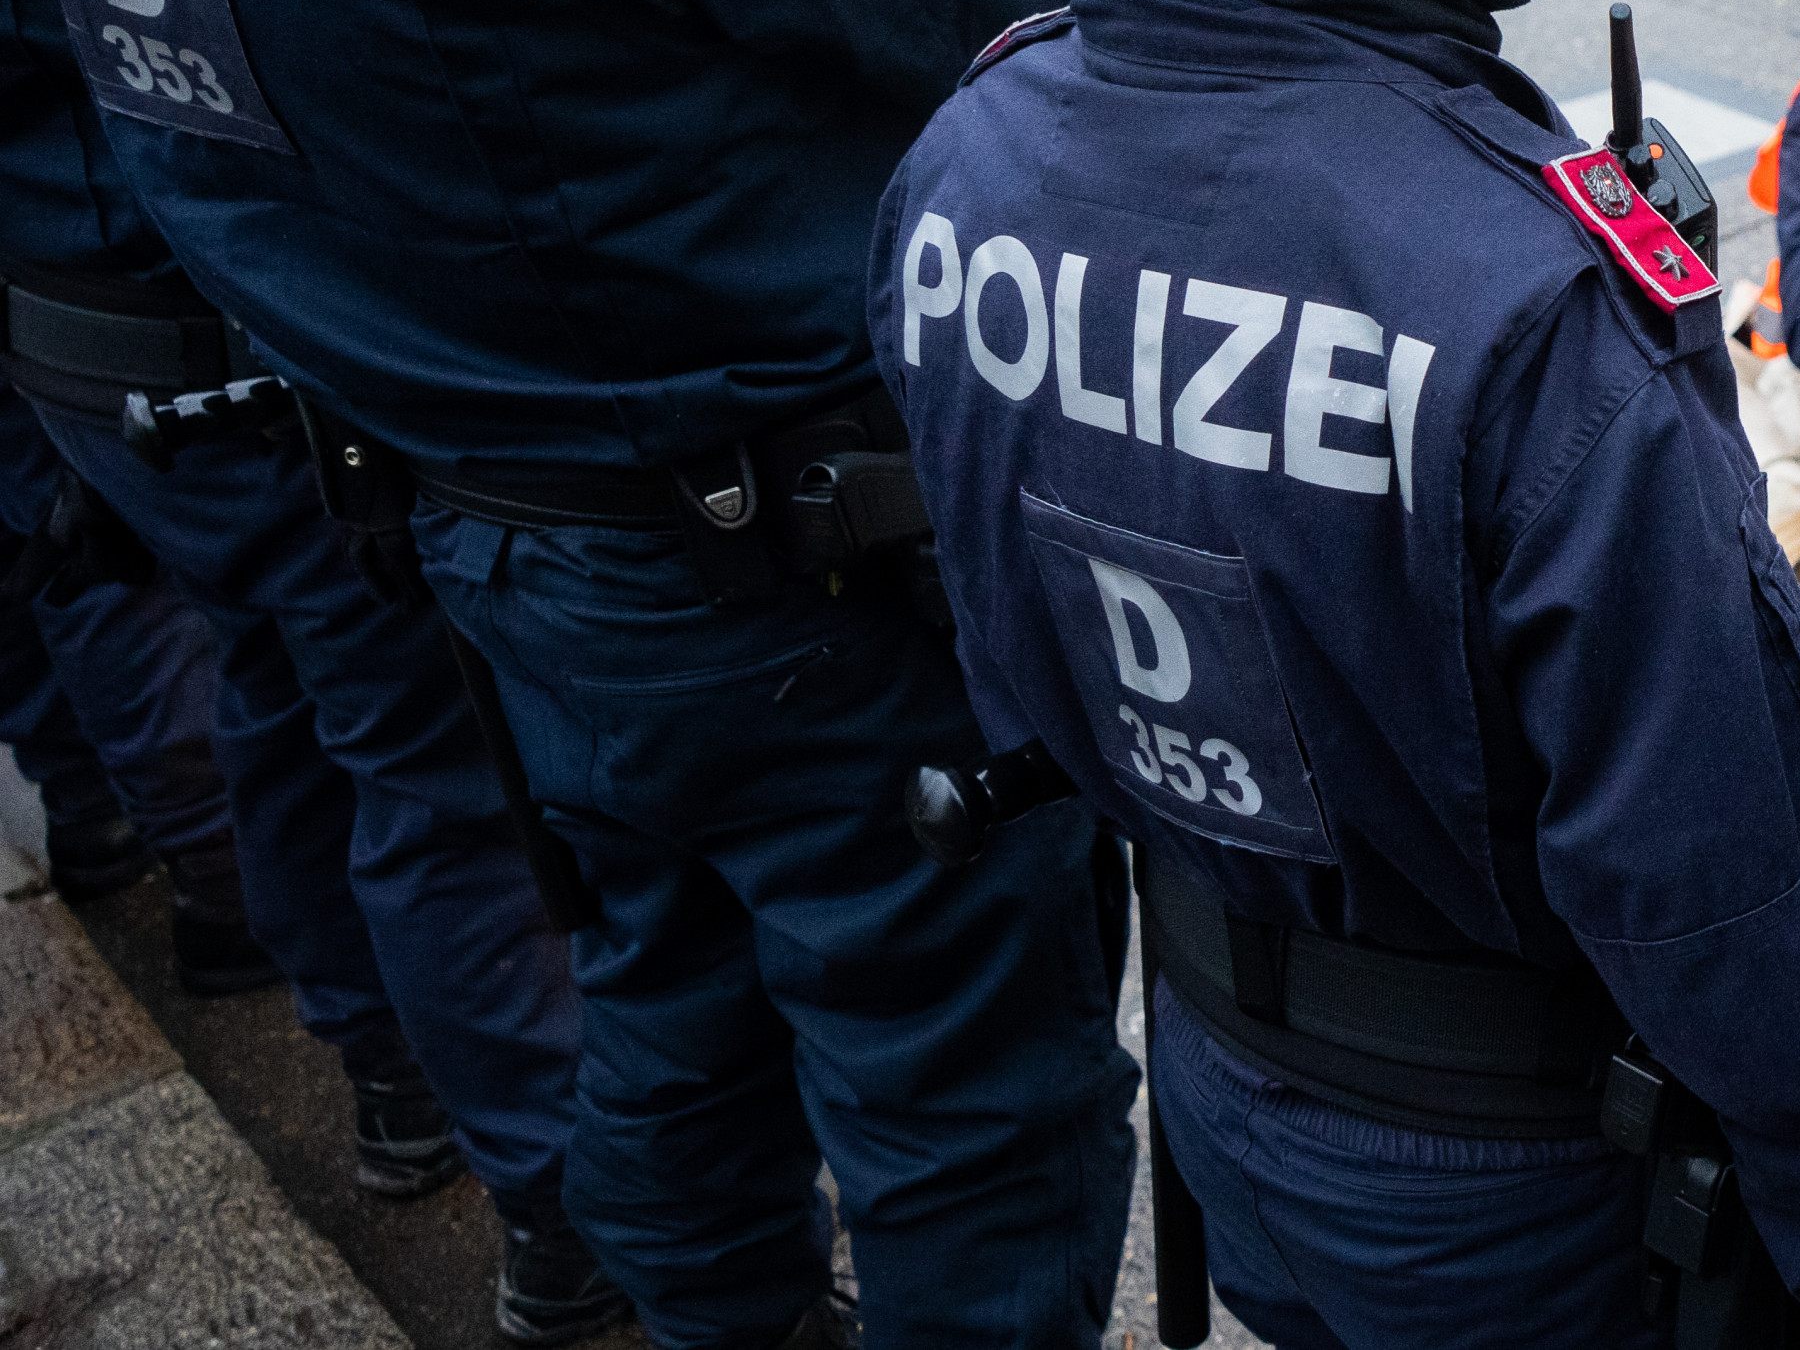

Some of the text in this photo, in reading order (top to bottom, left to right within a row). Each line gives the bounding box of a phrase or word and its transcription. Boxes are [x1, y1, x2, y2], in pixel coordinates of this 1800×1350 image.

[102, 24, 234, 115] 353
[903, 211, 1436, 514] POLIZEI
[1088, 557, 1192, 704] D
[1118, 703, 1263, 817] 353
